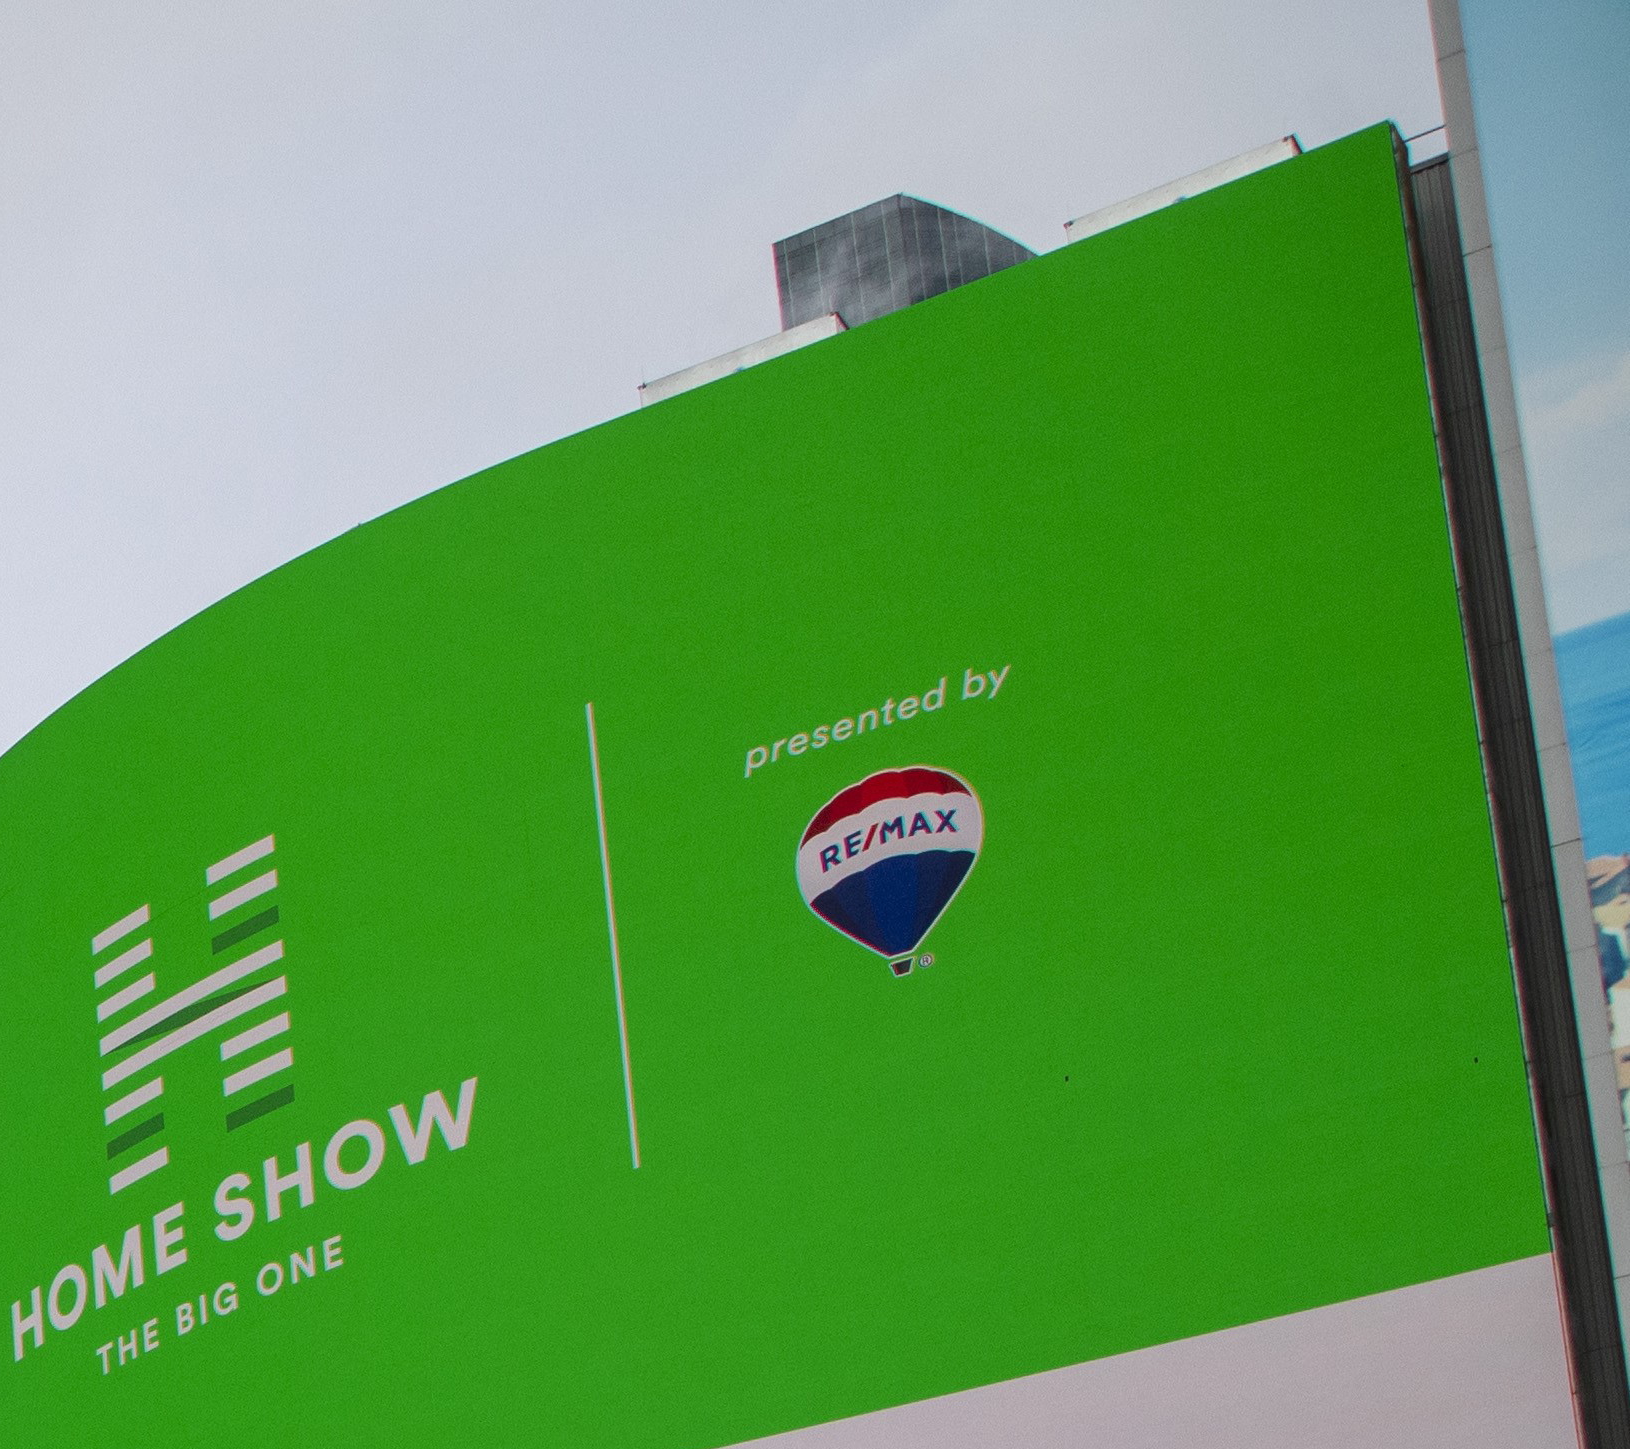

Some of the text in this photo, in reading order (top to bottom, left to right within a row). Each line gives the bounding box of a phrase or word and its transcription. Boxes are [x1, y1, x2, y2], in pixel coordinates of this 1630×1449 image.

[741, 662, 1012, 778] presented by
[816, 807, 962, 876] RE/MAX
[10, 1076, 480, 1362] HOME SHOW
[94, 1234, 347, 1377] THE BIG ONE
